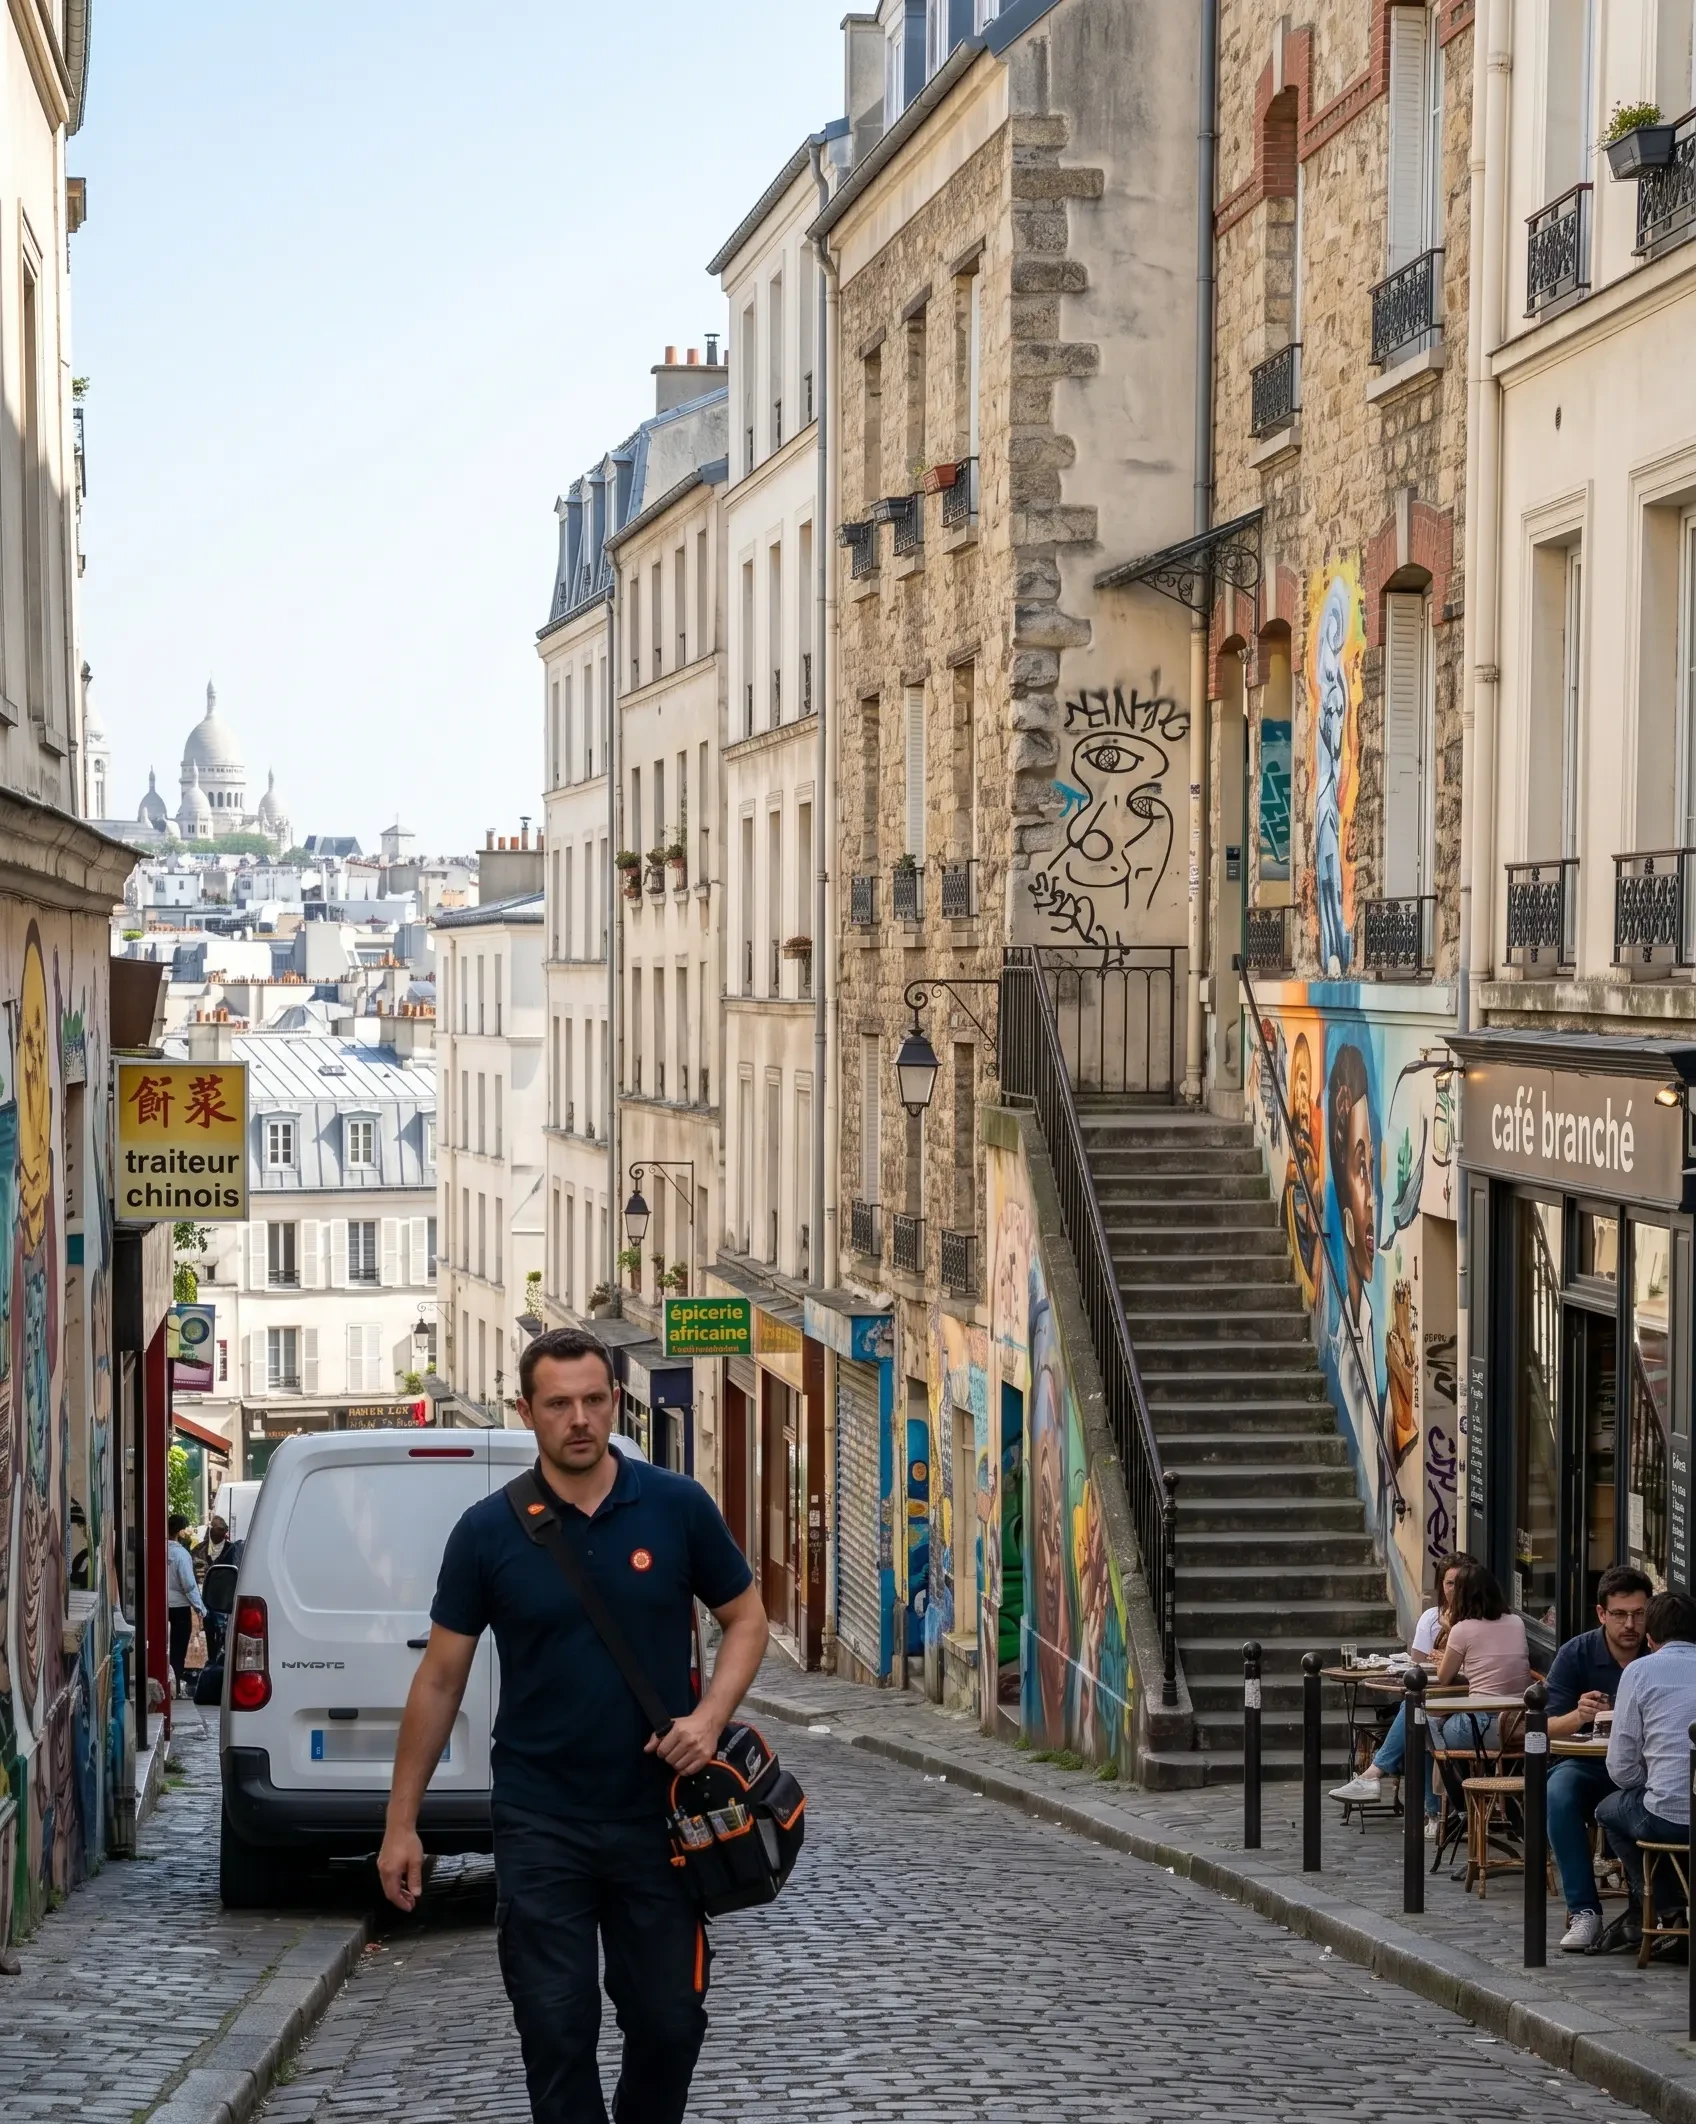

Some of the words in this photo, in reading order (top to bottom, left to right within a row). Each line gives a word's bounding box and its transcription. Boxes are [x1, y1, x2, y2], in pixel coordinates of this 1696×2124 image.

[1491, 1085, 1535, 1156] café
[1541, 1090, 1635, 1173] branché
[125, 1149, 240, 1174] traiteur
[126, 1182, 240, 1207] chinois
[670, 1304, 743, 1324] épicerie
[669, 1325, 748, 1341] africaine
